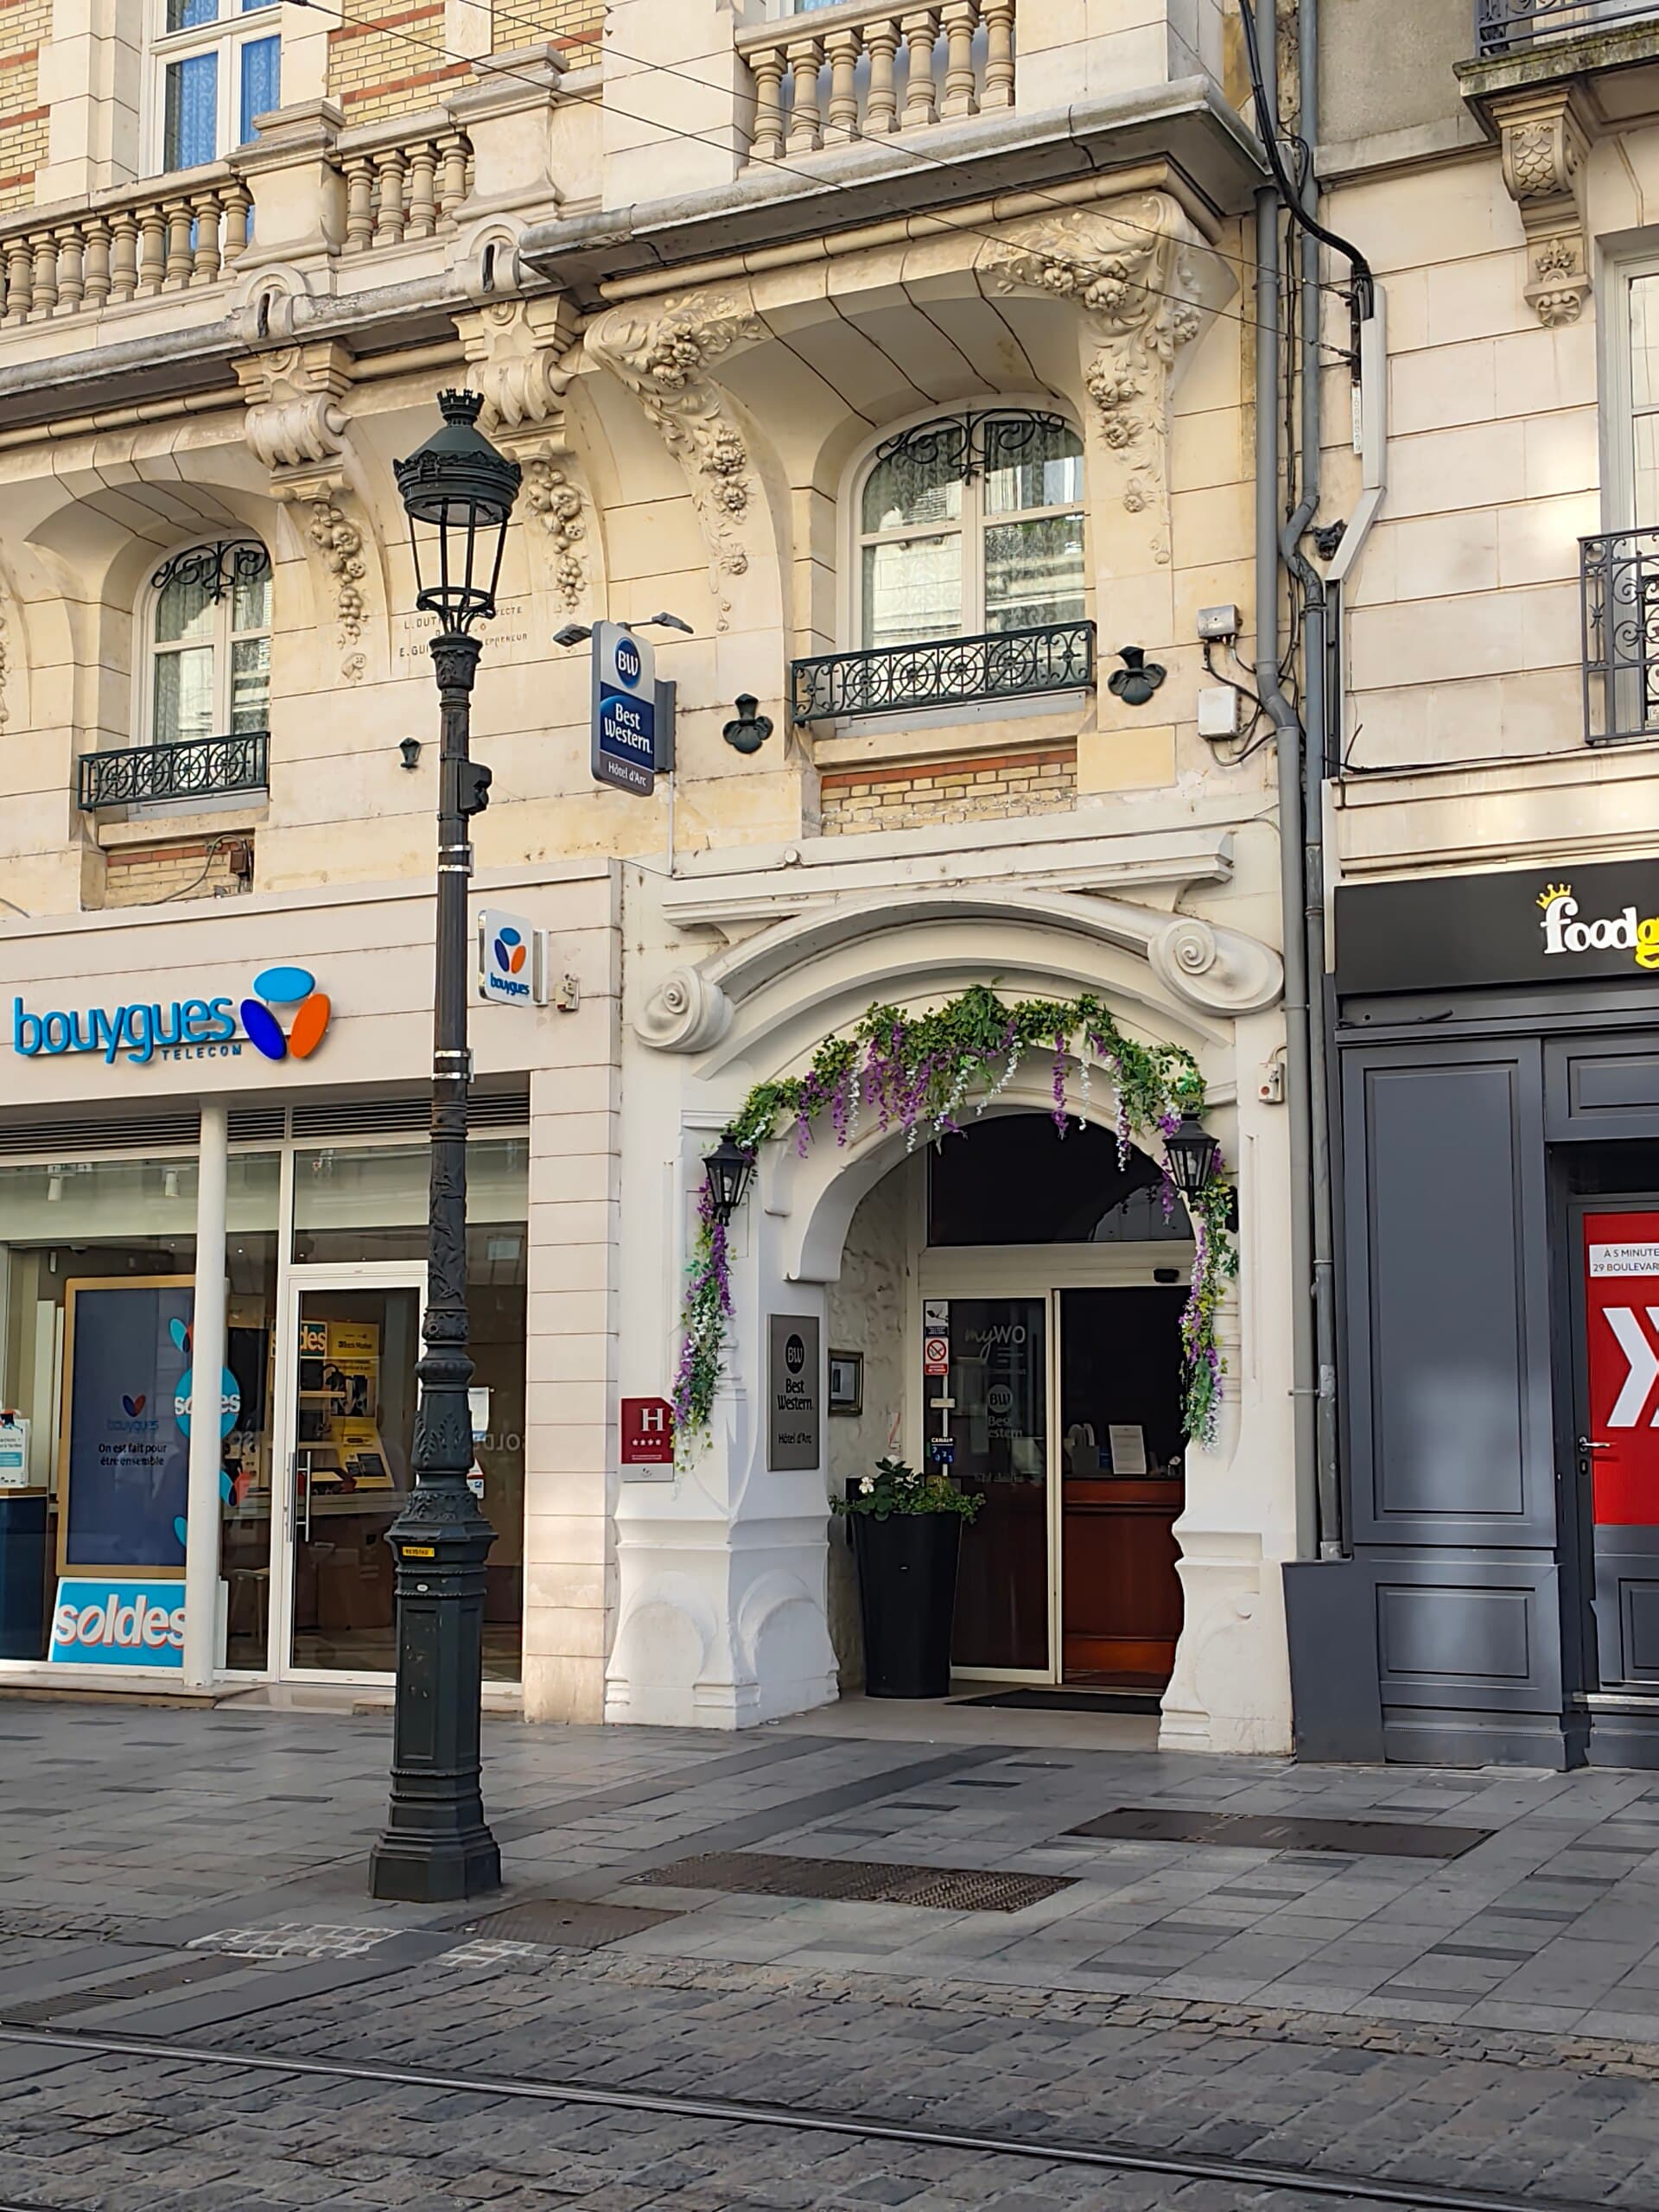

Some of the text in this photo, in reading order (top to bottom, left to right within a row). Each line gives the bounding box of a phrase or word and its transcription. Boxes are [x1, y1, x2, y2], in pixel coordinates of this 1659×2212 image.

[618, 650, 639, 677] BW
[614, 702, 640, 730] Best
[608, 760, 647, 787] Hôtel d'Arc
[490, 972, 530, 996] bouygues
[14, 996, 236, 1064] bouygues
[162, 1044, 242, 1061] TELECOM
[1592, 1263, 1605, 1272] 29
[787, 1348, 804, 1363] BW
[785, 1378, 804, 1394] Best
[641, 1408, 664, 1432] H
[99, 1443, 111, 1452] On
[128, 1443, 143, 1452] fait
[145, 1444, 167, 1454] pour
[120, 1456, 164, 1465] ensemble
